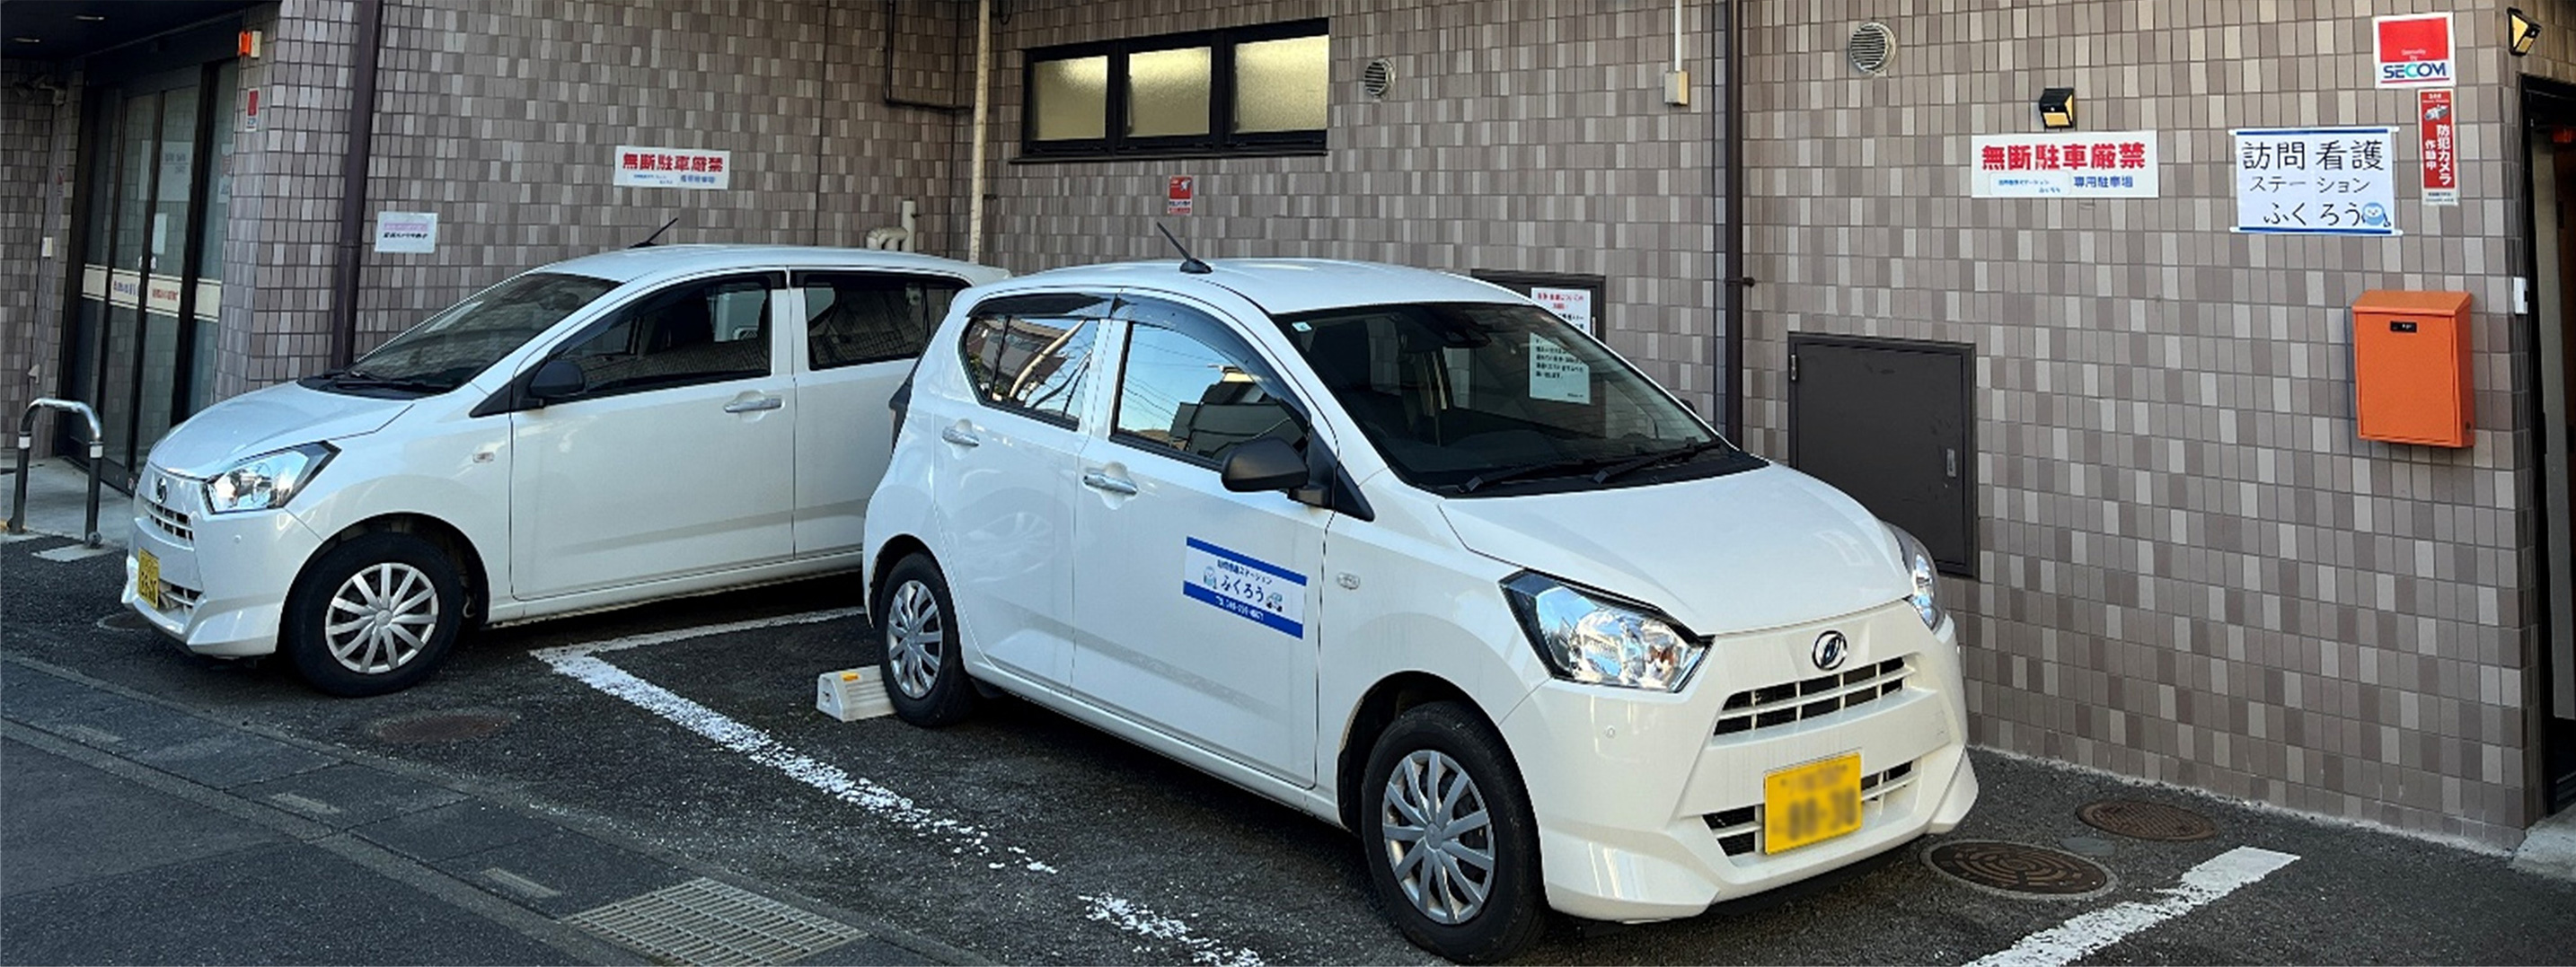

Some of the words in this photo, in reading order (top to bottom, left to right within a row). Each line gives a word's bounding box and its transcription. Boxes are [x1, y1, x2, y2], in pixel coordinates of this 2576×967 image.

[2383, 62, 2447, 78] SECOM
[622, 152, 723, 172] 無断駐車厳禁
[1981, 142, 2146, 171] 無断駐車厳禁
[2241, 139, 2385, 171] 訪問看護
[2425, 139, 2436, 171] 作動中
[2436, 124, 2452, 186] 防犯カメラ
[2074, 176, 2134, 189] 専用駐車場
[2249, 176, 2371, 193] ステーション
[2263, 202, 2361, 226] ふくろう
[1222, 575, 1265, 602] ふくろう
